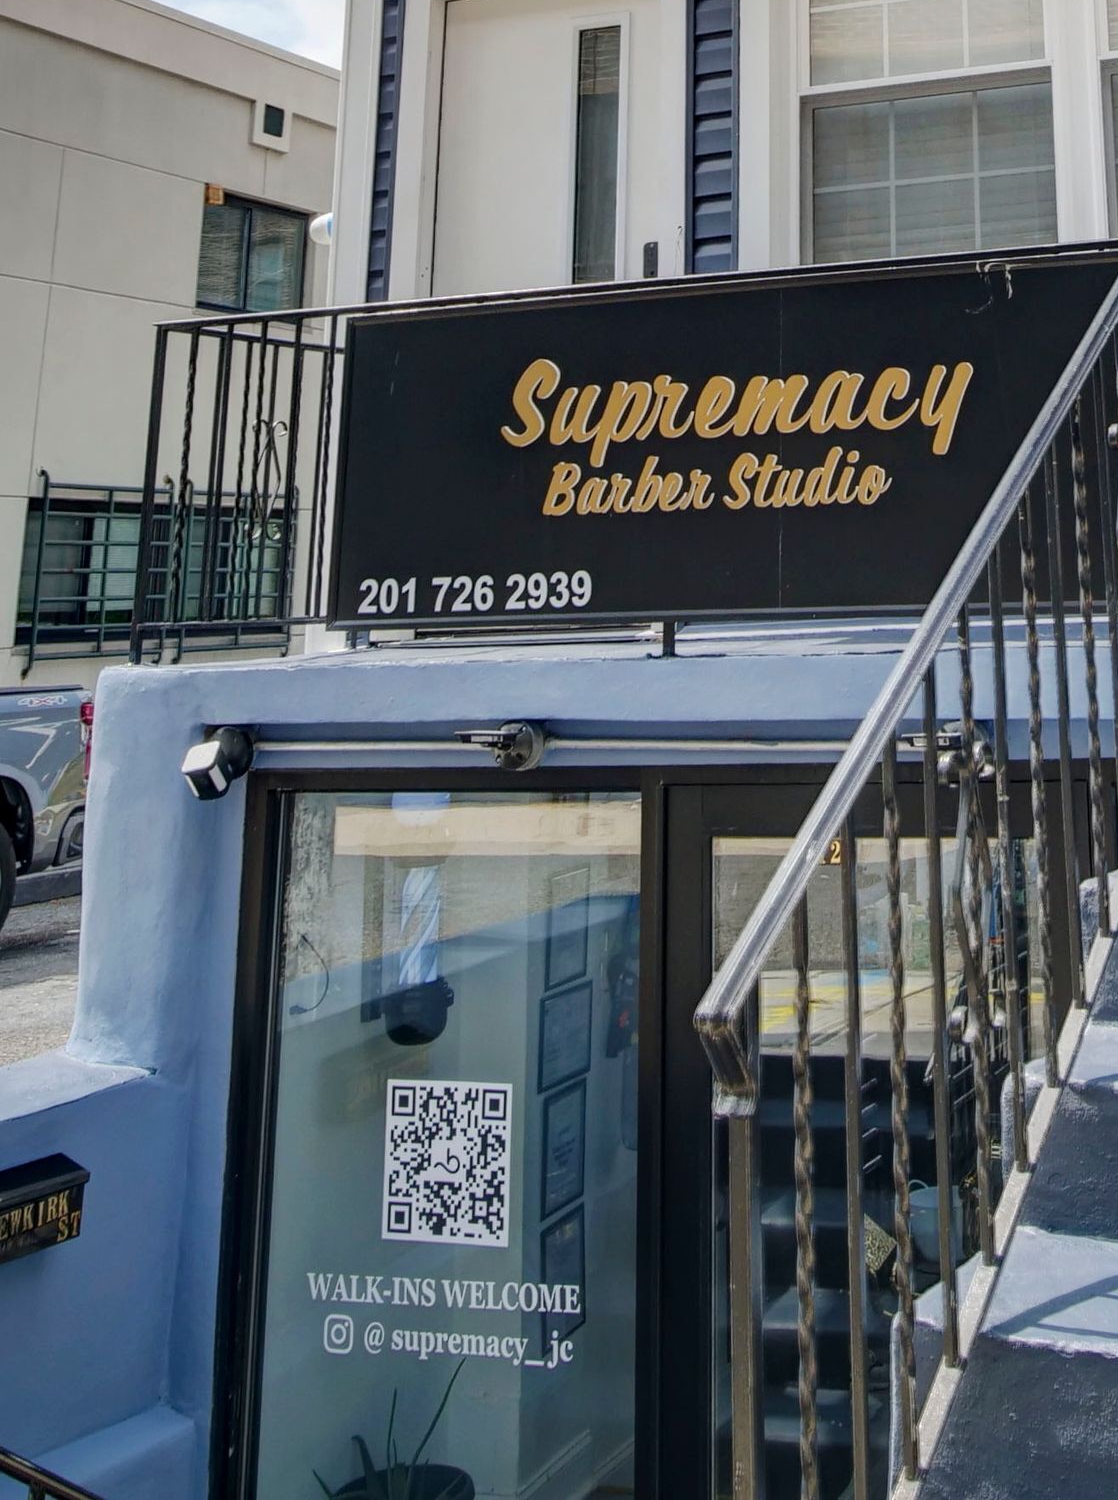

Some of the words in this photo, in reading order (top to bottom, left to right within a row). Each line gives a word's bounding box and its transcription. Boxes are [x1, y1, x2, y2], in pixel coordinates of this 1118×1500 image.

[500, 357, 974, 468] Supremacy
[542, 455, 714, 516] Barber
[723, 445, 892, 511] Studio
[357, 577, 417, 614] 201
[431, 575, 494, 612] 726
[504, 570, 592, 610] 2939
[58, 1211, 81, 1241] ST
[307, 1272, 436, 1307] WALK-INS
[441, 1279, 581, 1314] WELCOME
[391, 1330, 574, 1368] supremacy_jc
